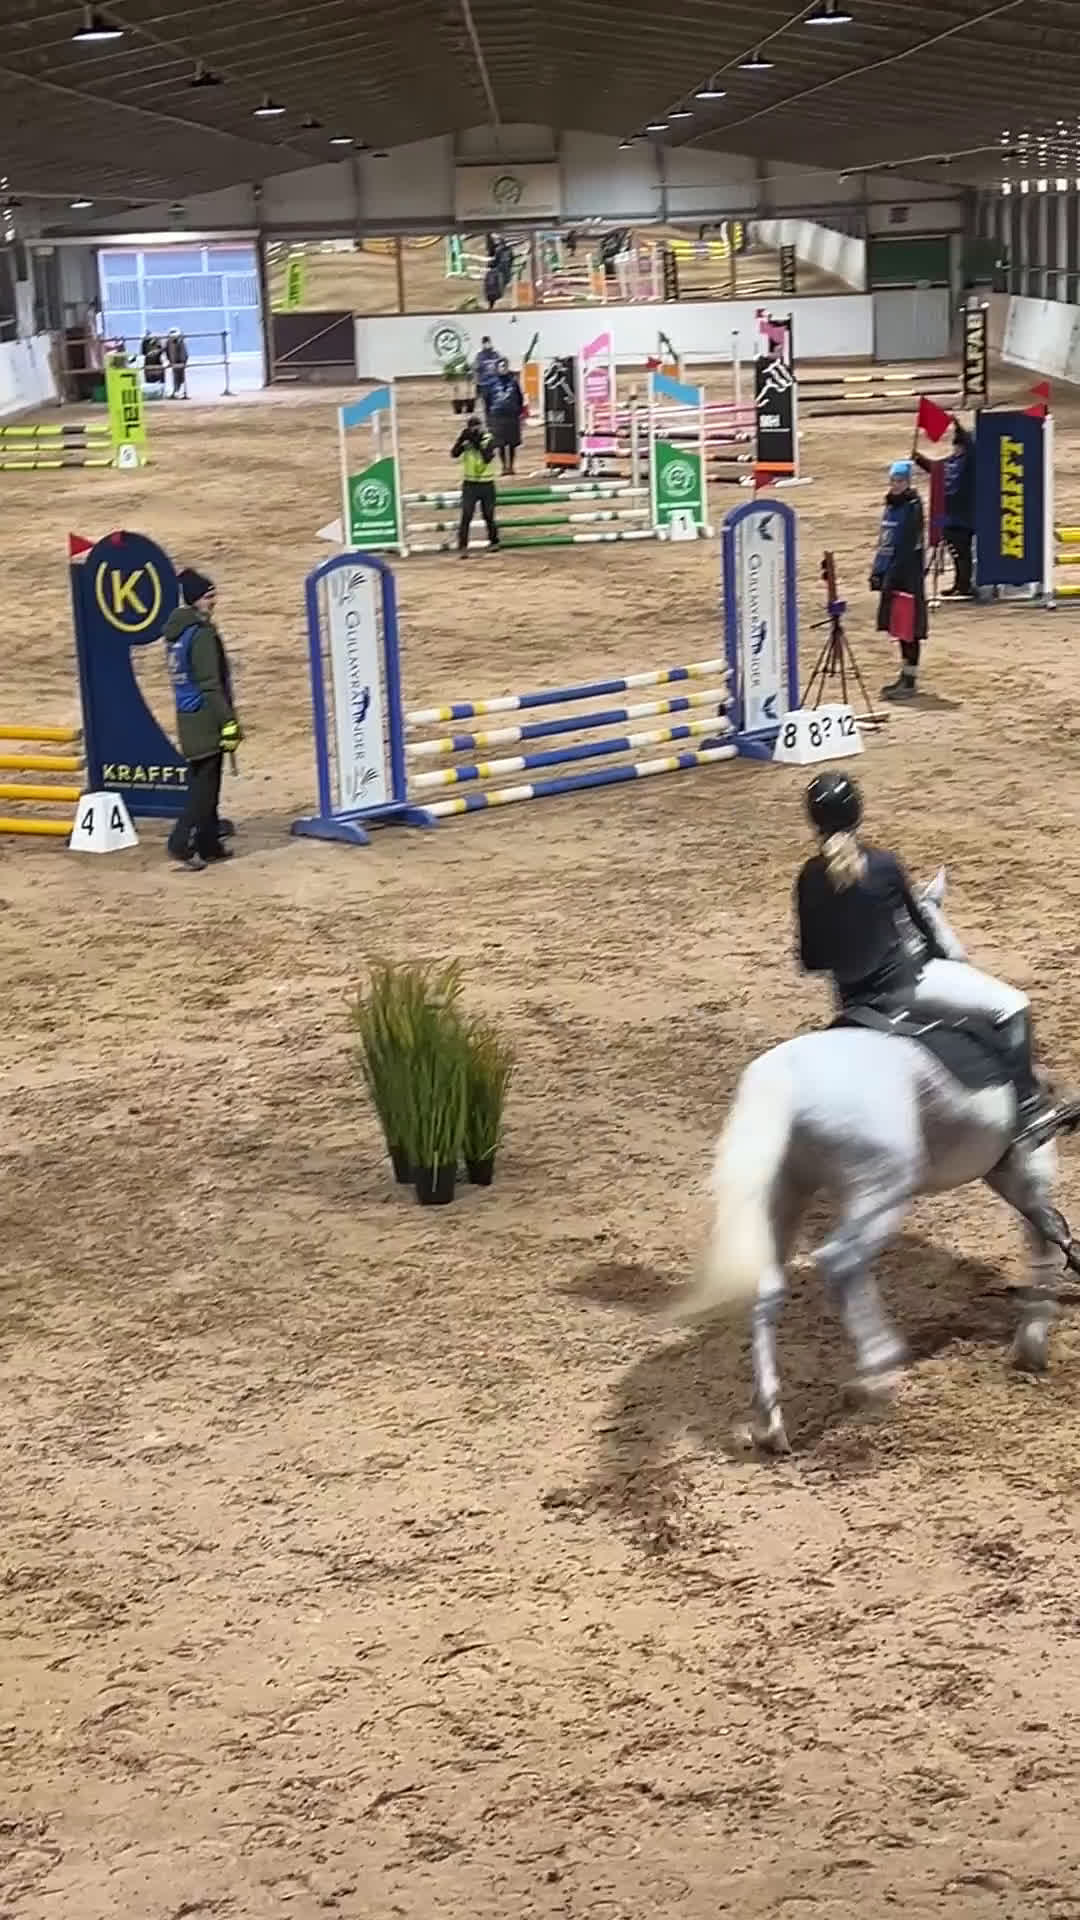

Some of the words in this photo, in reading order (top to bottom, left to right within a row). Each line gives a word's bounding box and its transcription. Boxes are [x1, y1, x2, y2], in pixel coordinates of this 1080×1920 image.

[1000, 434, 1024, 559] KRAFFT
[111, 569, 148, 613] K
[783, 722, 797, 748] 8
[837, 715, 857, 737] 12
[102, 763, 189, 783] KRAFFT
[81, 807, 95, 836] 4
[111, 805, 124, 833] 4
